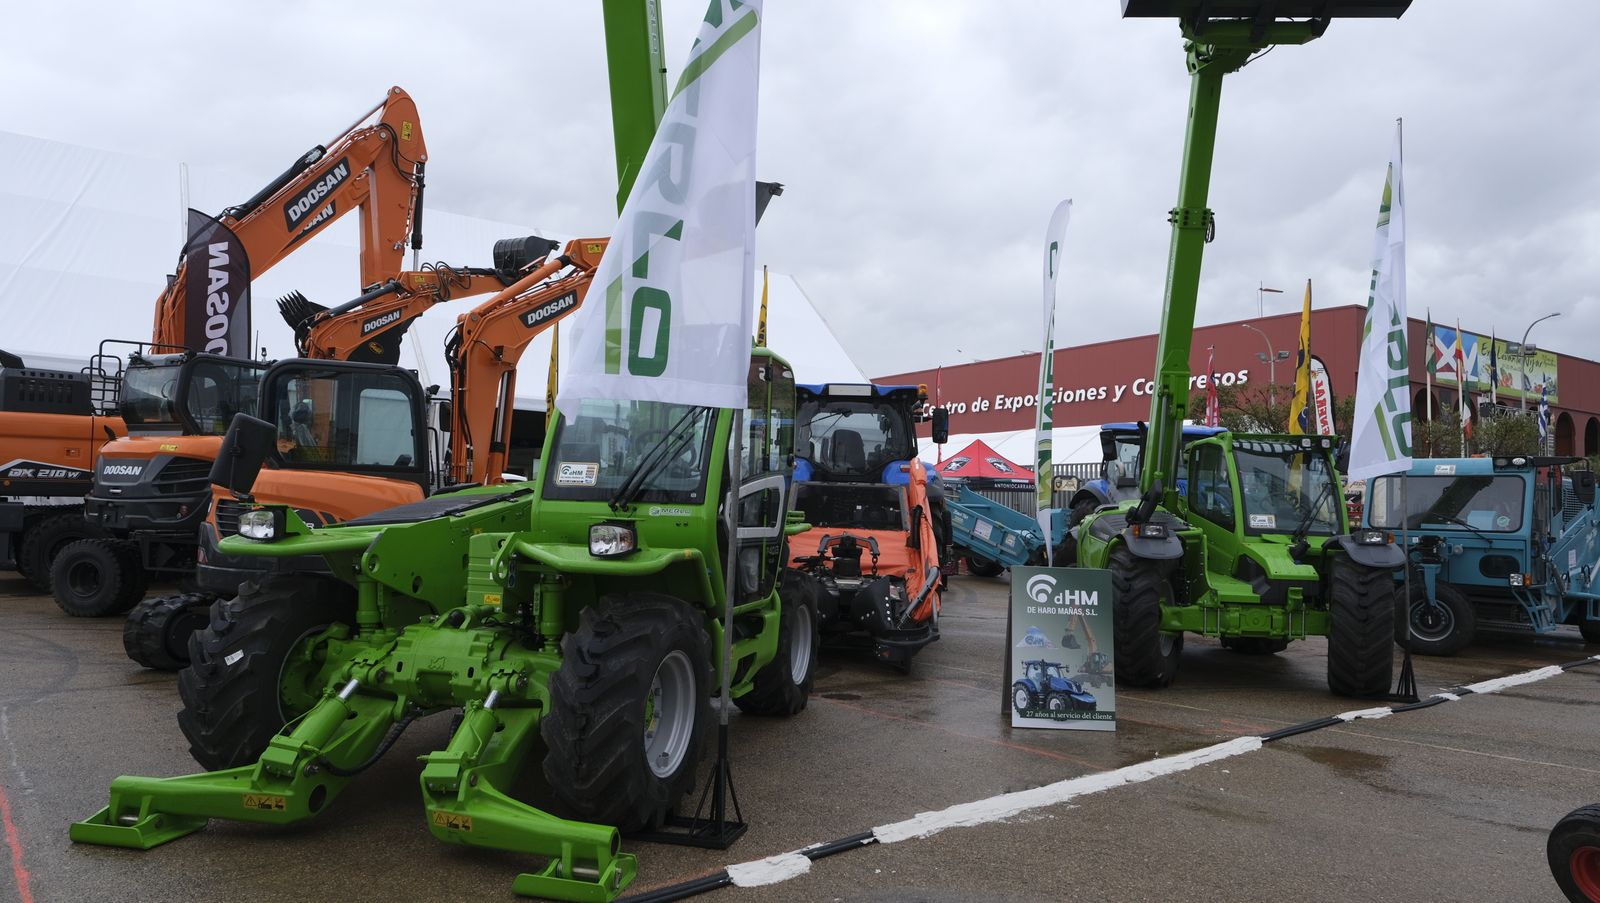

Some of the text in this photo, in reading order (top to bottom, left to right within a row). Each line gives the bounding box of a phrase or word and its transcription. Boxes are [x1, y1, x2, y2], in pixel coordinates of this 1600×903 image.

[287, 162, 348, 222] DOOSAN
[527, 294, 574, 325] DOOSAN
[364, 310, 400, 333] DOOSAN
[922, 369, 1249, 418] Cetro de Expoiones y Coresos
[8, 468, 36, 479] DX
[103, 465, 143, 476] DOOSAN
[1054, 589, 1098, 606] dHM
[1027, 606, 1098, 616] DE HARO MAÑAS, S.L.
[1057, 711, 1081, 719] servicio
